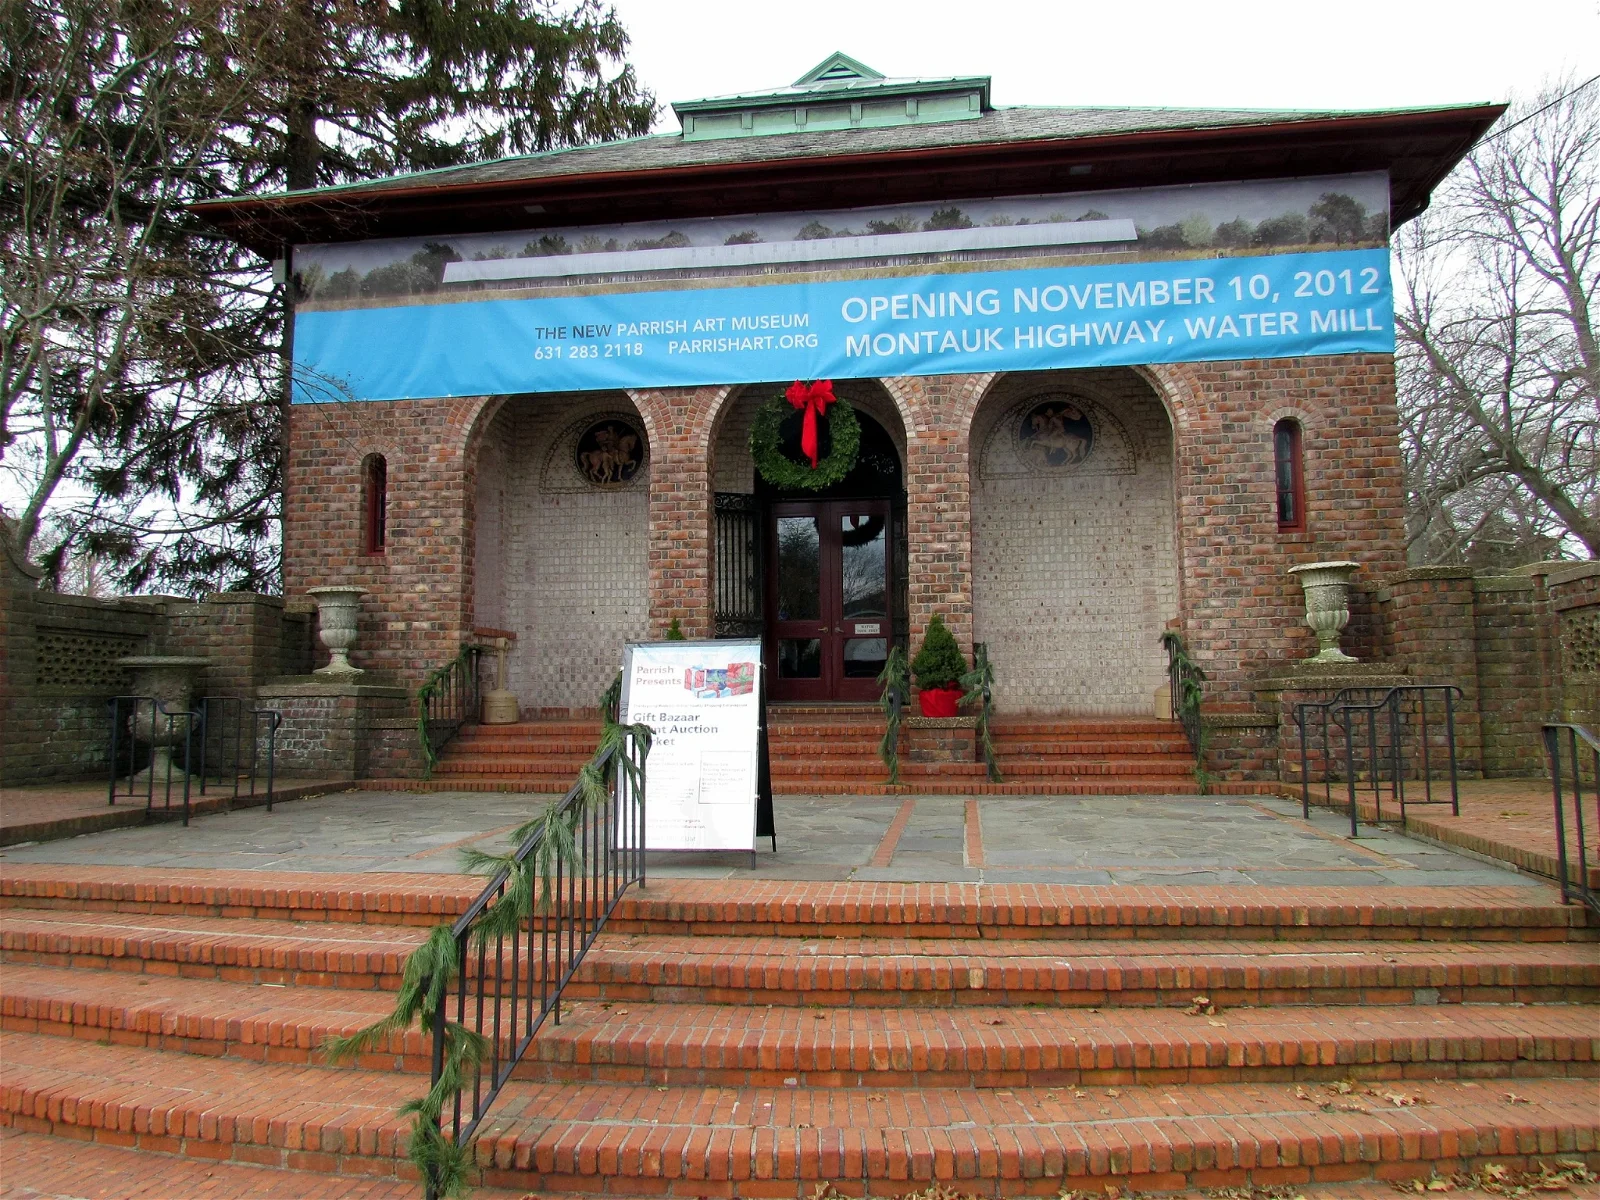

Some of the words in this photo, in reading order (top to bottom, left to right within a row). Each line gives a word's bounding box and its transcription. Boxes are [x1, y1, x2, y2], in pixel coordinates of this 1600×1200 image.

[841, 289, 1001, 323] OPENING
[1013, 277, 1215, 314] NOVEMBER
[1227, 274, 1280, 304] 10,
[1294, 267, 1380, 298] 2012
[535, 327, 567, 340] THE
[572, 325, 613, 339] NEW
[617, 320, 687, 337] PARRISH
[693, 318, 727, 333] ART
[731, 313, 810, 331] MUSEUM
[846, 327, 1004, 358] MONTAUK
[1014, 319, 1174, 350] HIGHWAY,
[1184, 311, 1299, 340] WATER
[1310, 308, 1383, 334] MILL
[534, 346, 562, 360] 631
[569, 345, 599, 359] 283
[605, 342, 644, 357] 2118
[668, 333, 819, 355] PARRISHART.ORG
[636, 666, 675, 674] Parrish
[635, 677, 681, 686] Presents
[633, 712, 656, 722] Gift
[659, 712, 701, 722] Bazaar
[669, 724, 719, 734] Auction
